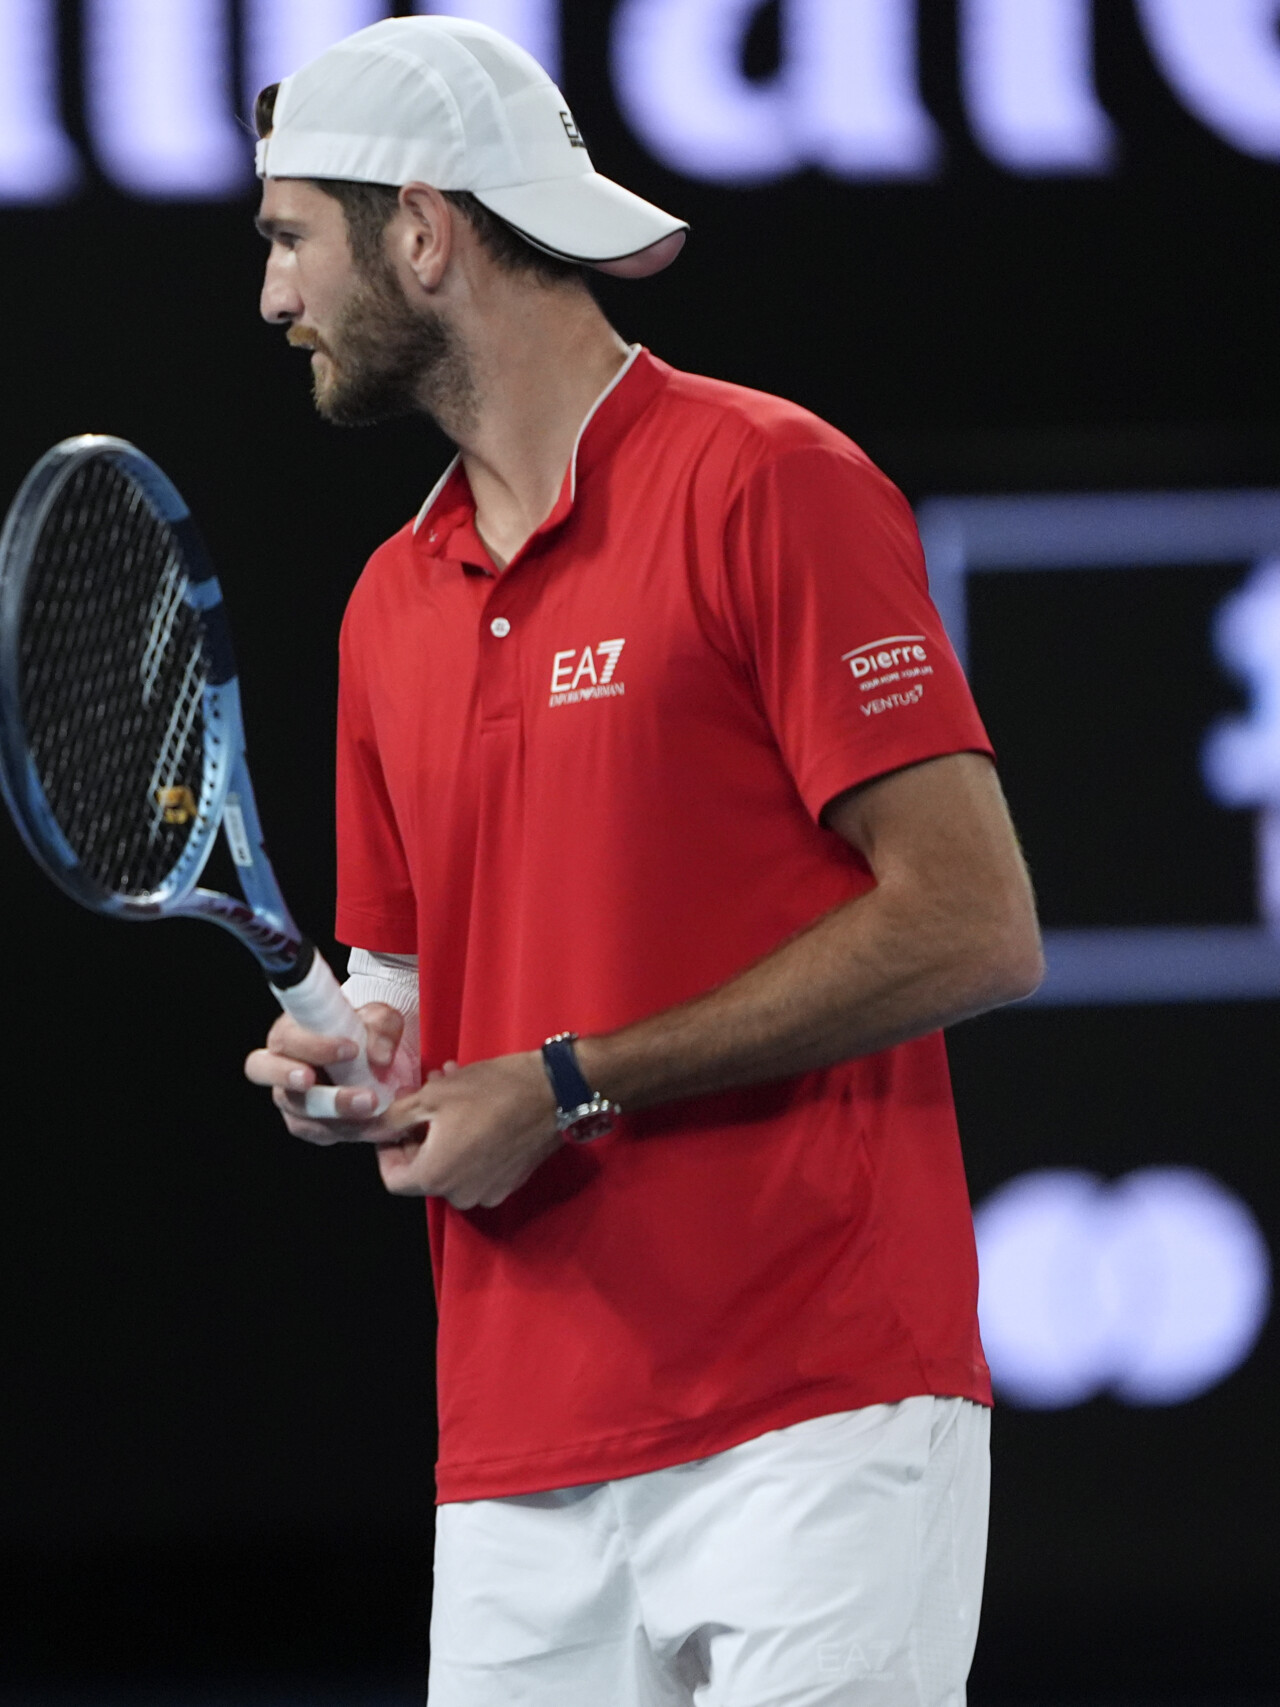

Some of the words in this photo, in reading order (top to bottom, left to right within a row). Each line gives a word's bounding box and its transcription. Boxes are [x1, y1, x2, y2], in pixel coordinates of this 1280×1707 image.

[550, 637, 626, 693] EA7
[849, 644, 927, 678] Dierre
[817, 1640, 892, 1672] EA7
